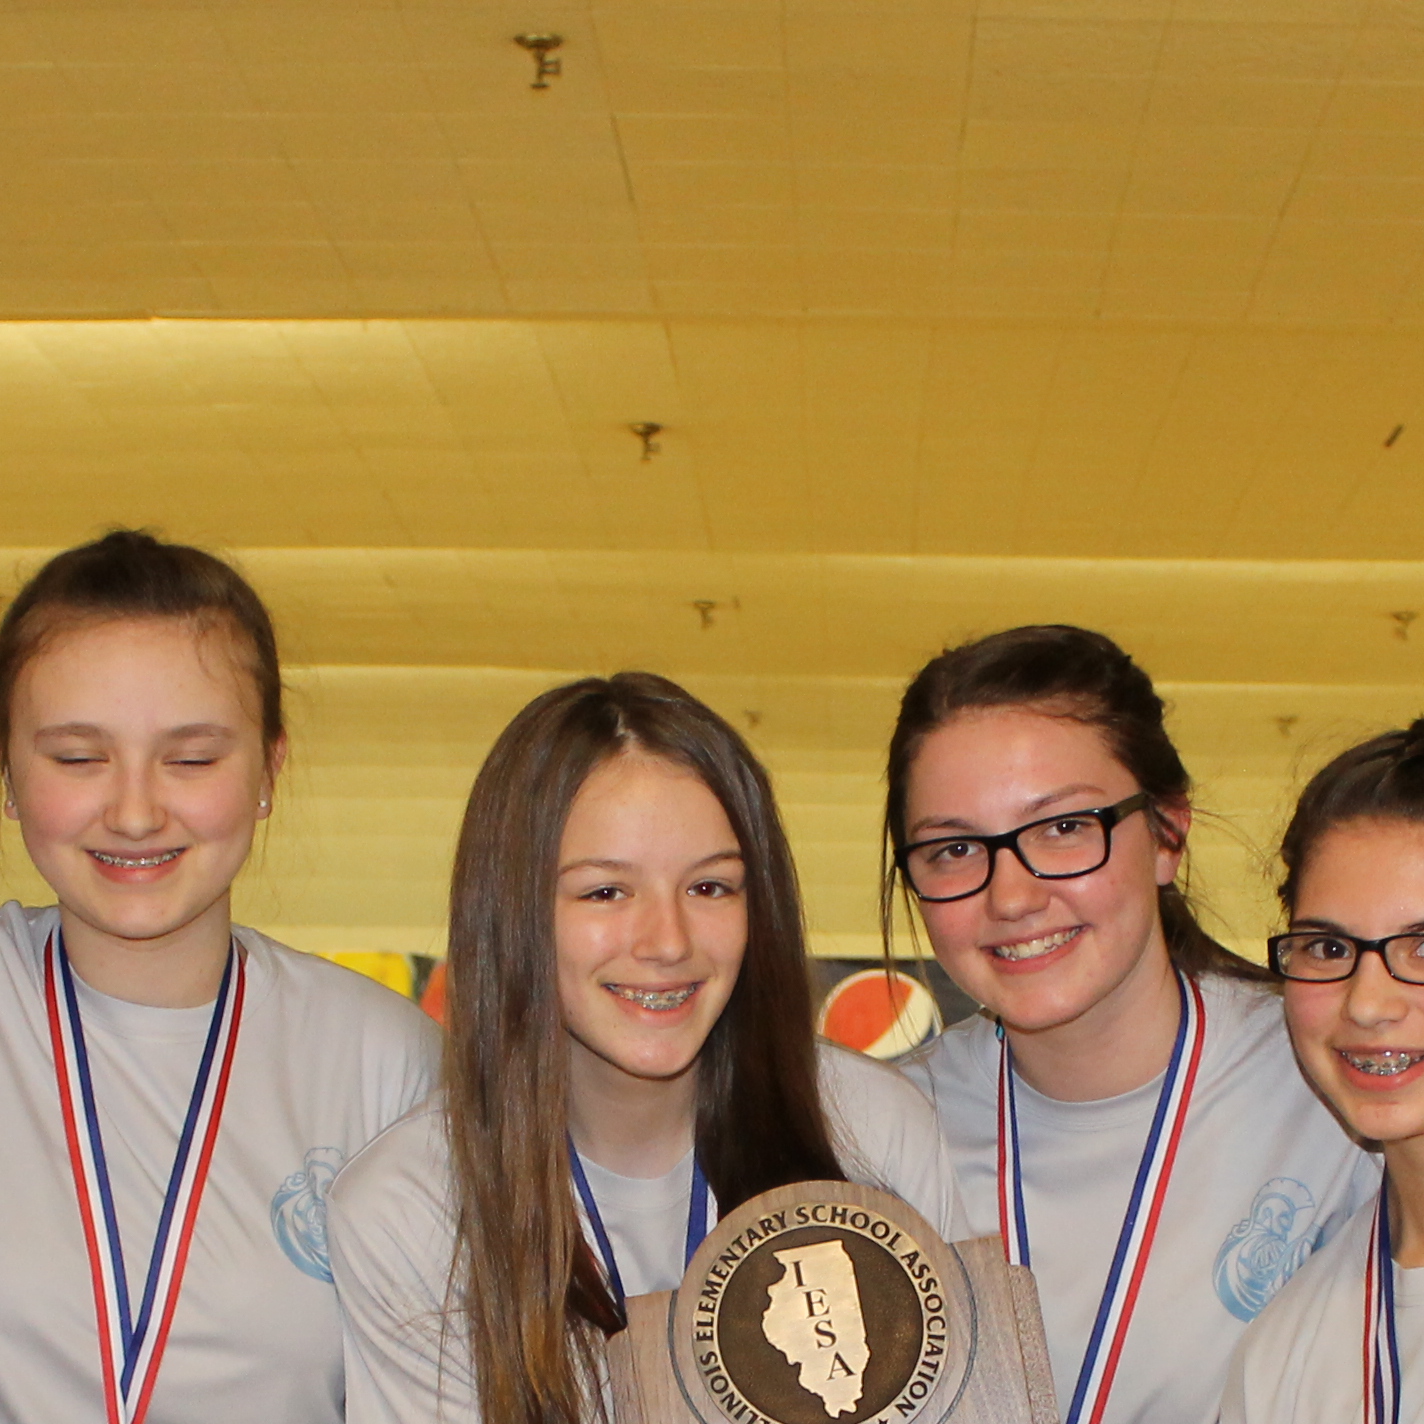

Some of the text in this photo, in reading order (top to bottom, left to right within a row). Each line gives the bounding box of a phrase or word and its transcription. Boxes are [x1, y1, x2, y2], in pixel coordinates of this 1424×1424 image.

[695, 1210, 789, 1343] ELEMENTARY
[795, 1203, 903, 1252] SCHOOL
[900, 1248, 947, 1419] ASSOCIATION
